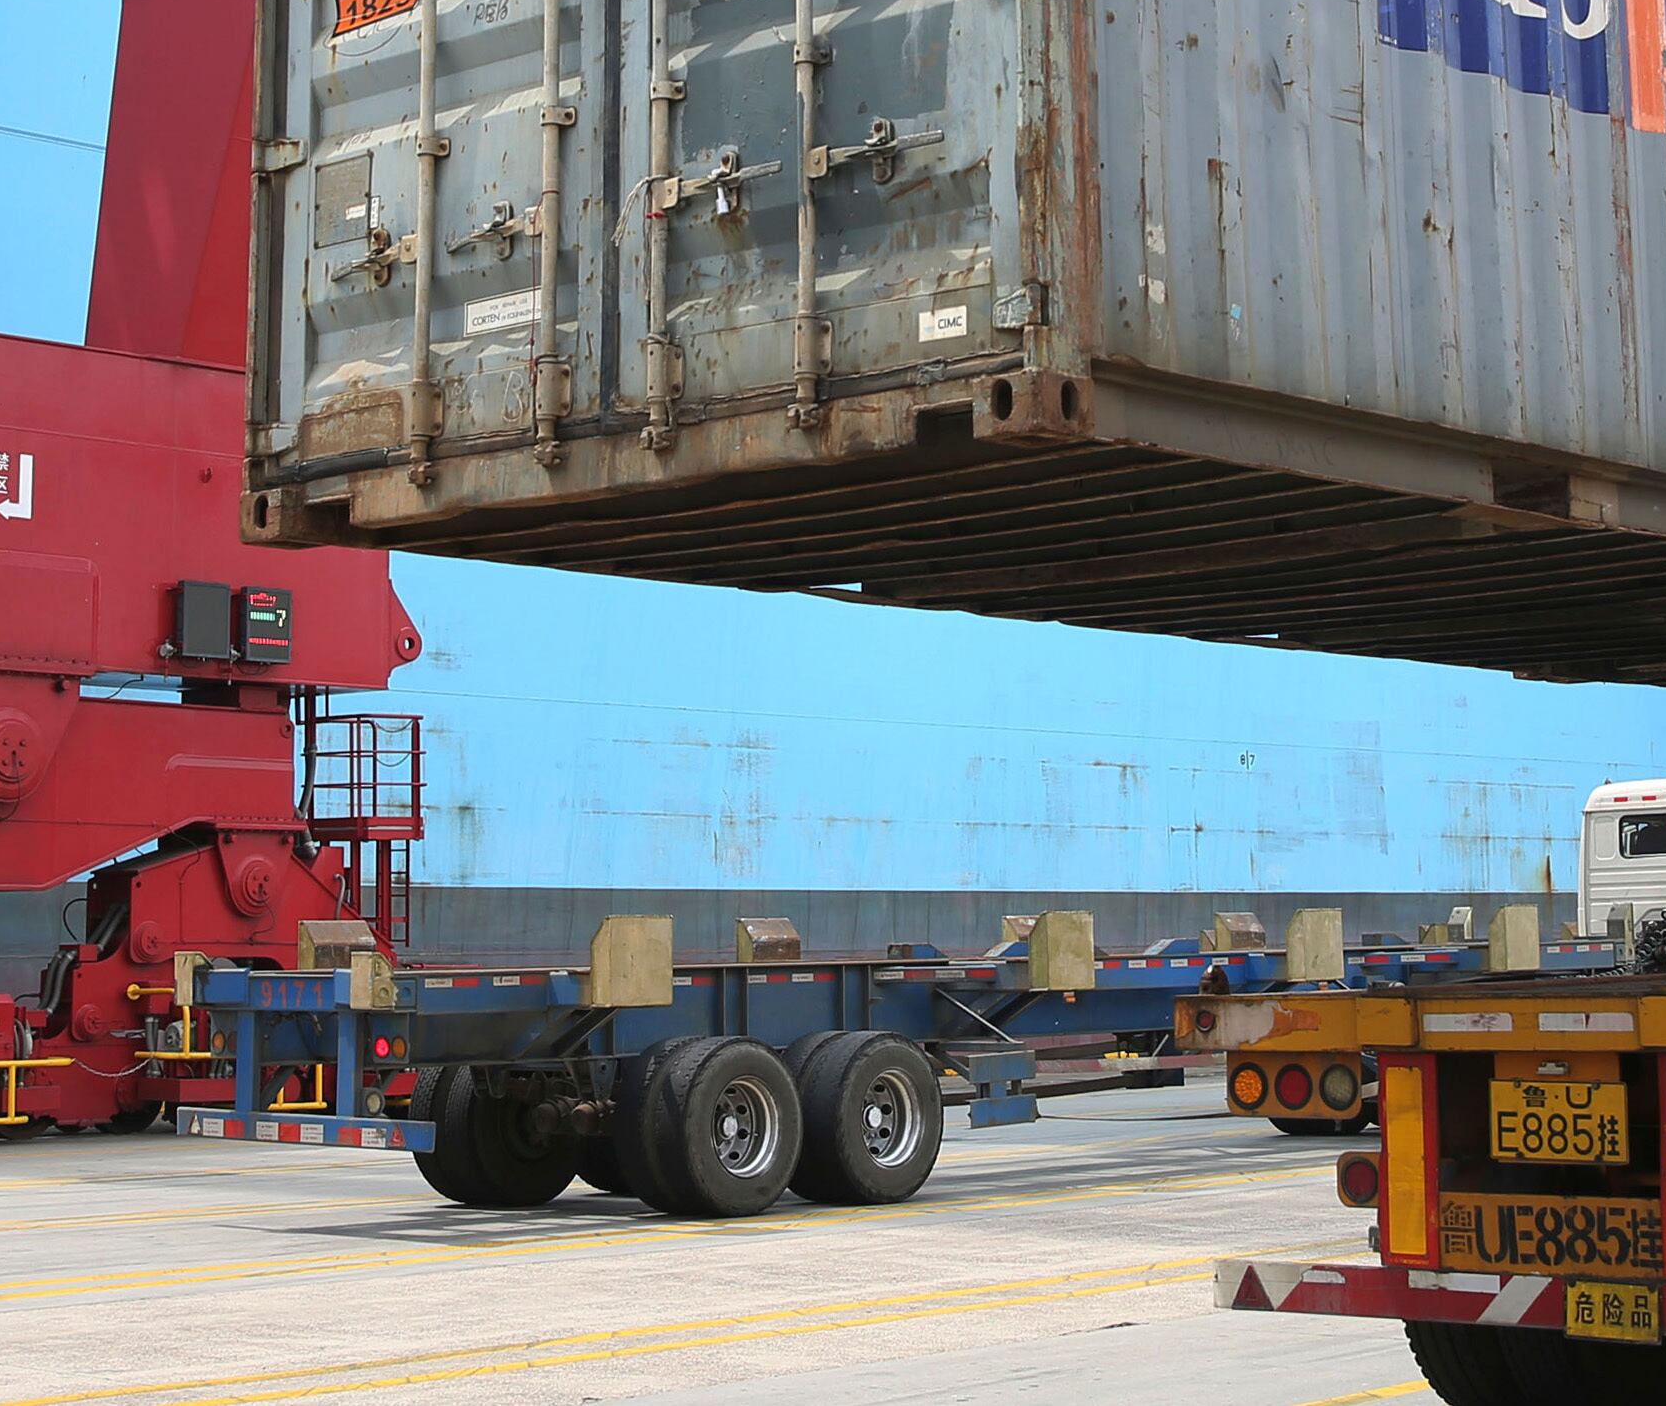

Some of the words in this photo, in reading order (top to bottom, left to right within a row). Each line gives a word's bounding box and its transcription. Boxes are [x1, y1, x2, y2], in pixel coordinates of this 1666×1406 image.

[472, 312, 501, 326] CORTEN
[938, 316, 962, 330] CIMC
[276, 609, 287, 628] 7
[261, 980, 323, 1008] 9171
[1497, 1111, 1621, 1157] E885挂
[1575, 1290, 1653, 1330] 危险品
